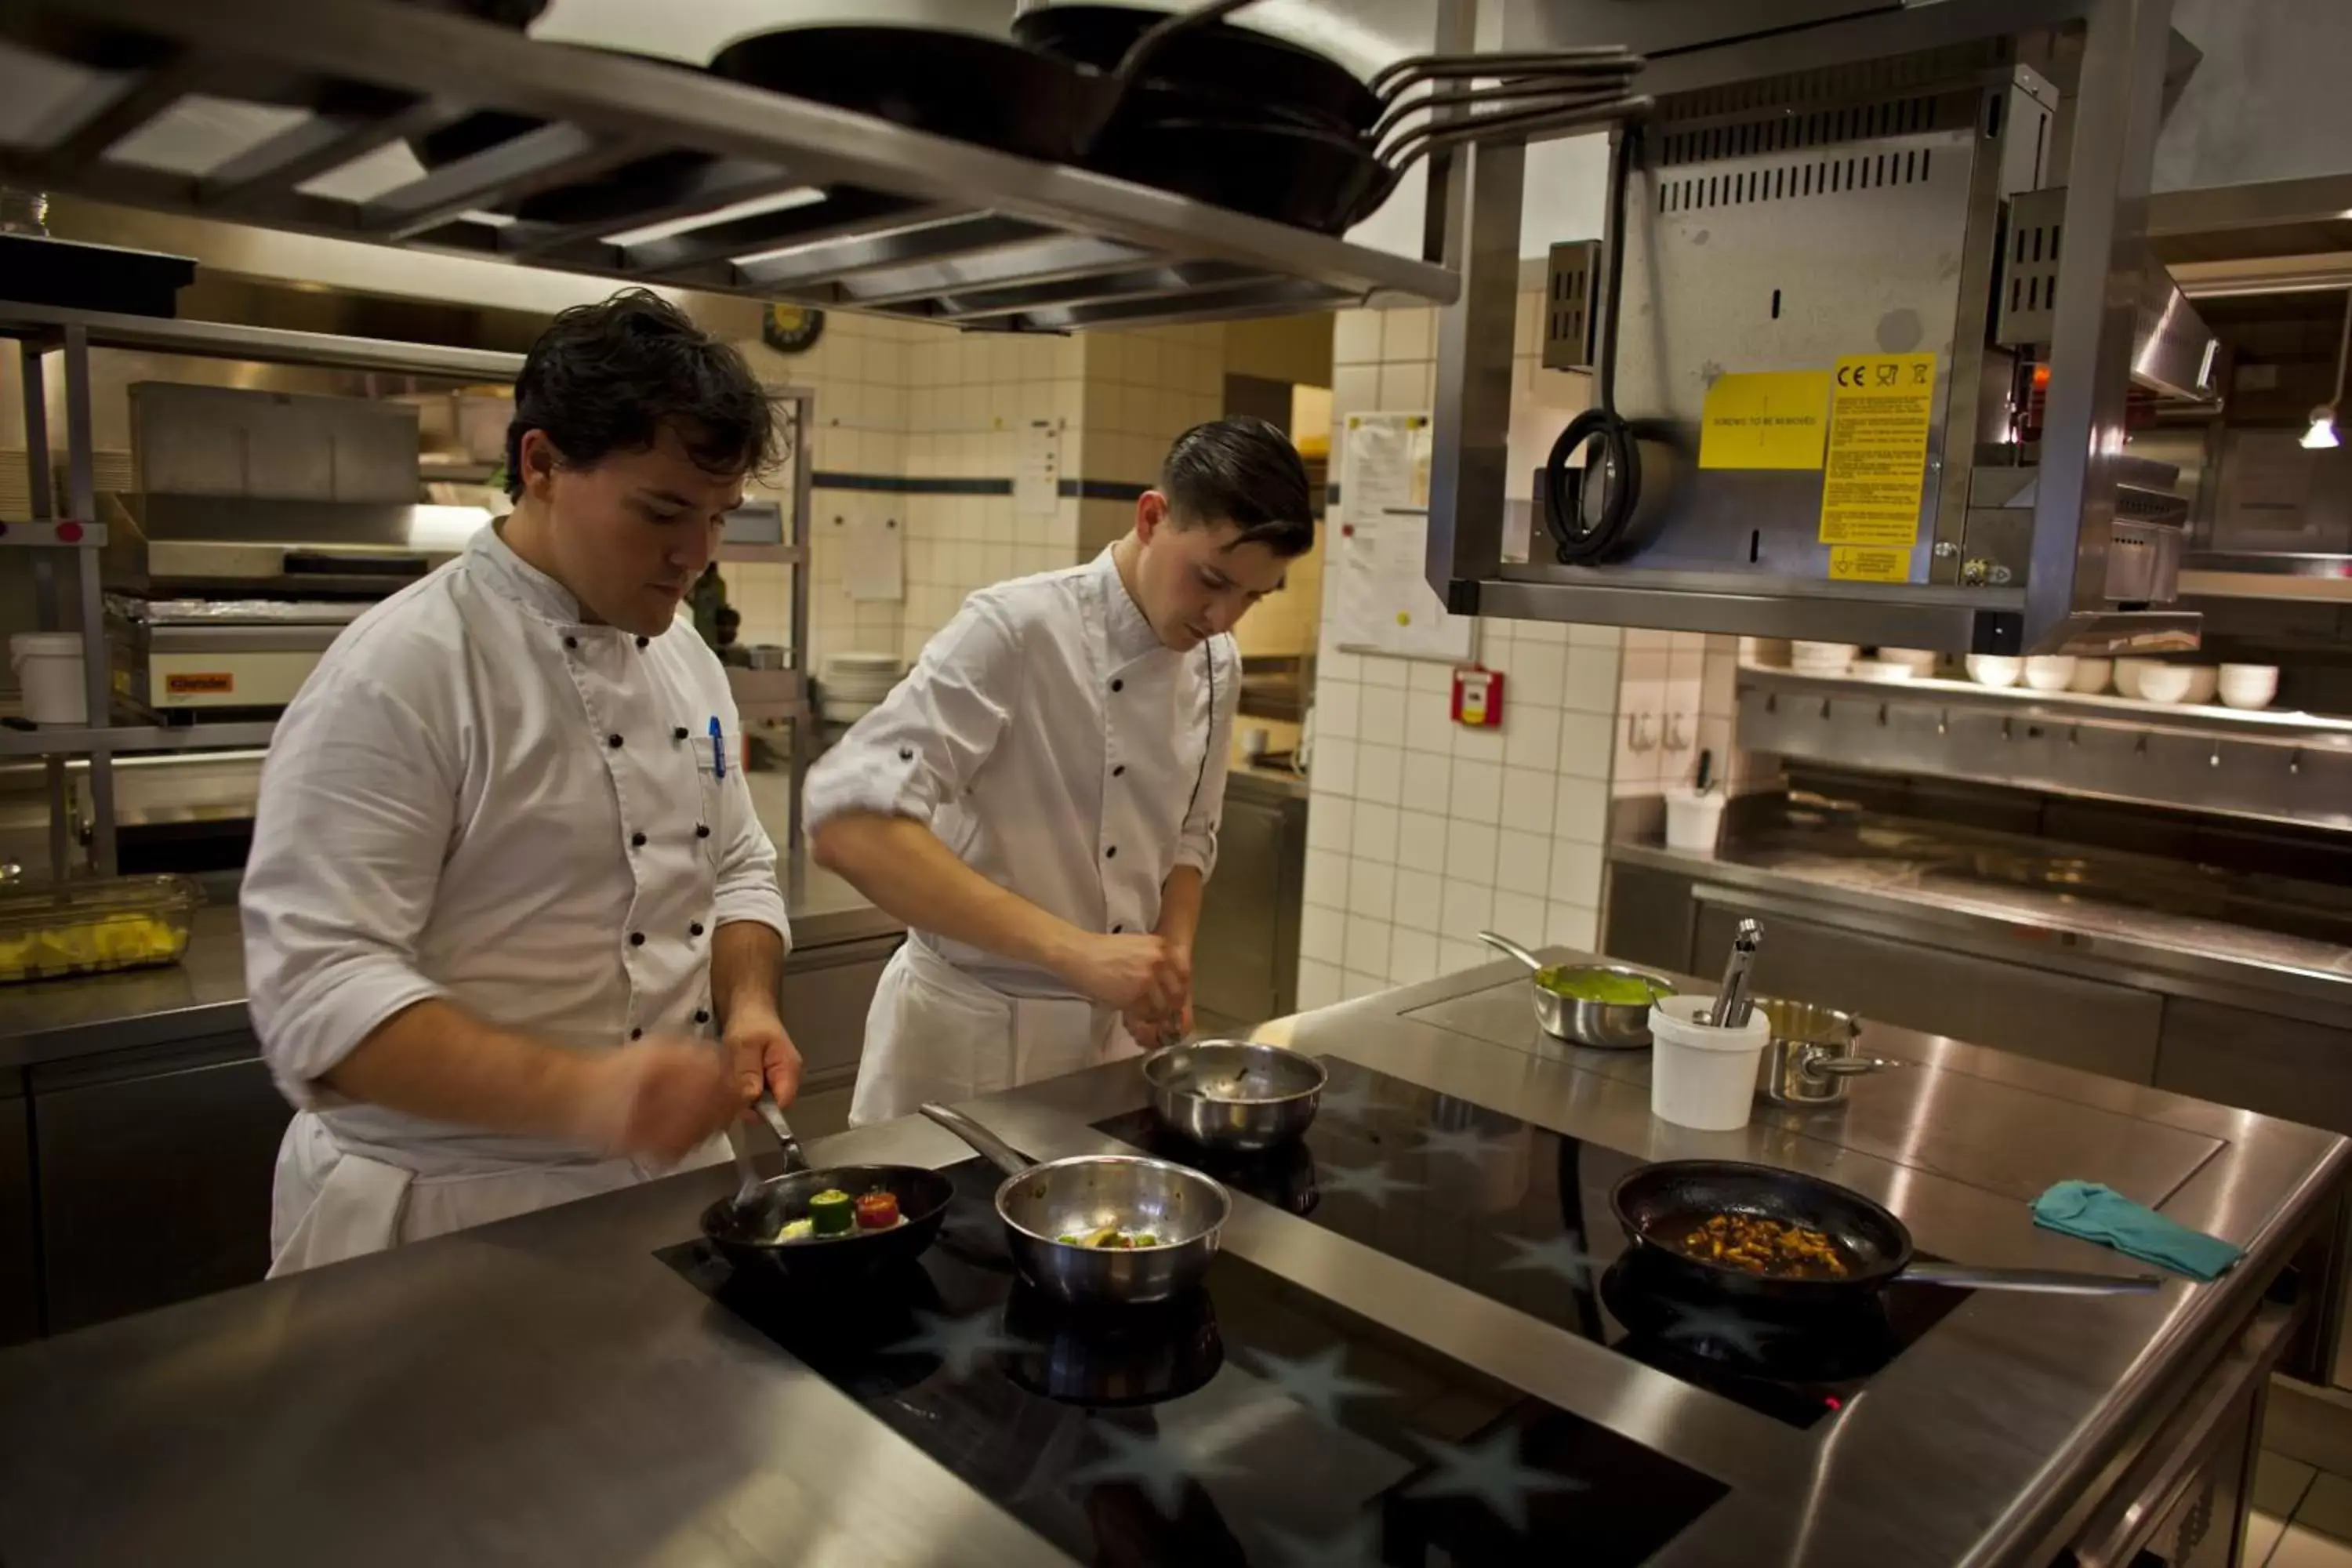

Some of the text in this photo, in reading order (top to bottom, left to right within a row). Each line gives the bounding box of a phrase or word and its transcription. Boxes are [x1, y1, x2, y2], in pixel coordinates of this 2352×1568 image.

[1838, 365, 1866, 387] CE
[1749, 416, 1762, 426] TO
[1763, 416, 1773, 426] BE
[1775, 415, 1817, 426] REMOVED
